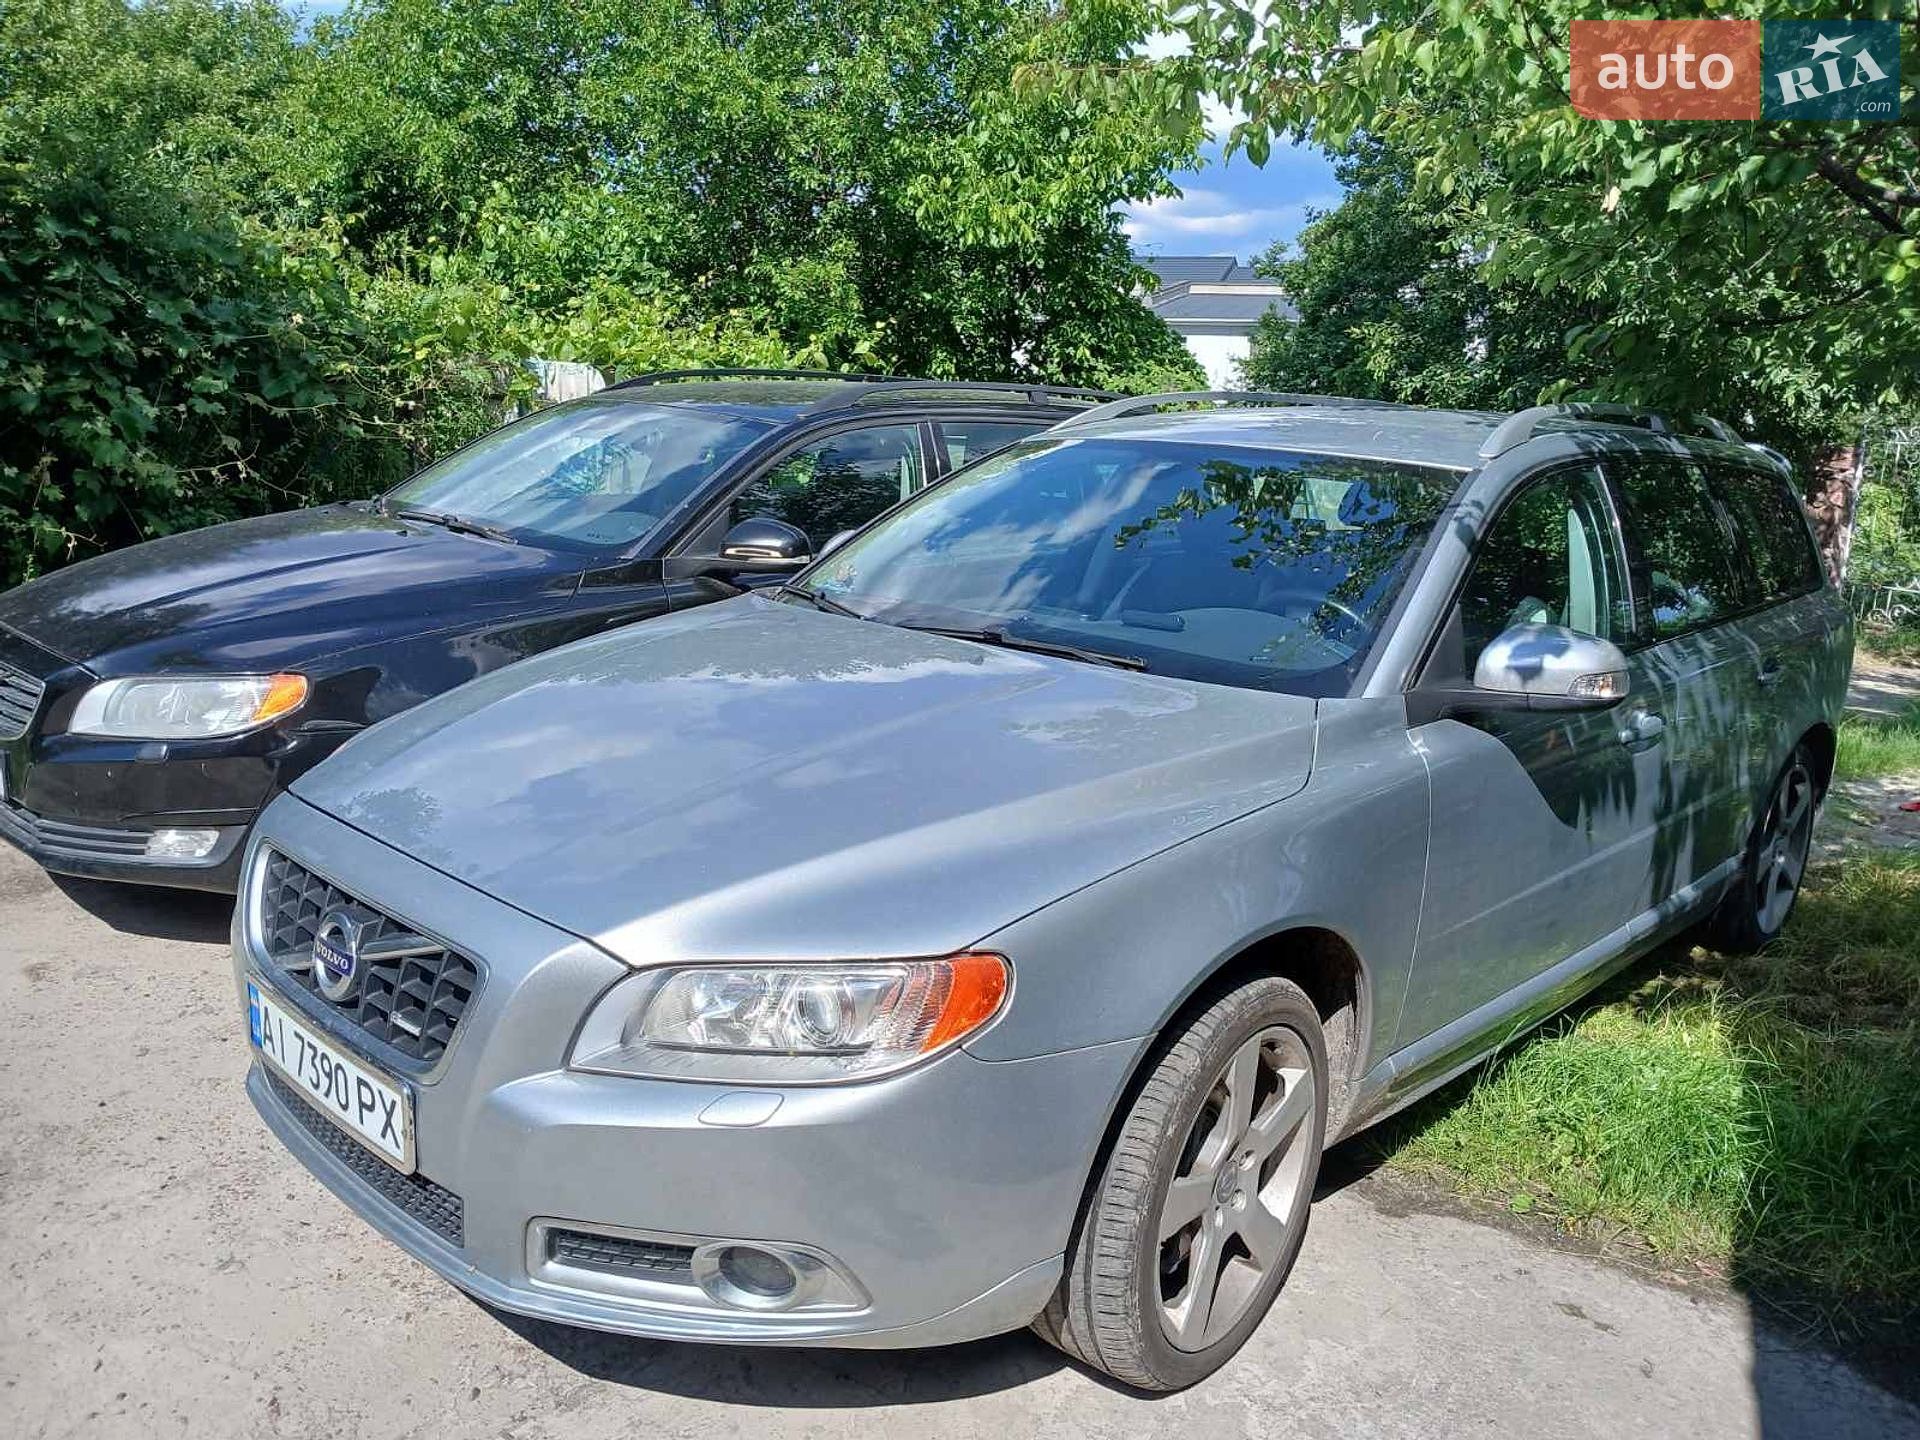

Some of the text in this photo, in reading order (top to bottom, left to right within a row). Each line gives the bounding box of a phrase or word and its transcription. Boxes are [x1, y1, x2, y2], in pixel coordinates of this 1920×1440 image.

[316, 940, 349, 970] VOLVO
[263, 1006, 401, 1150] AI 7390 PX
